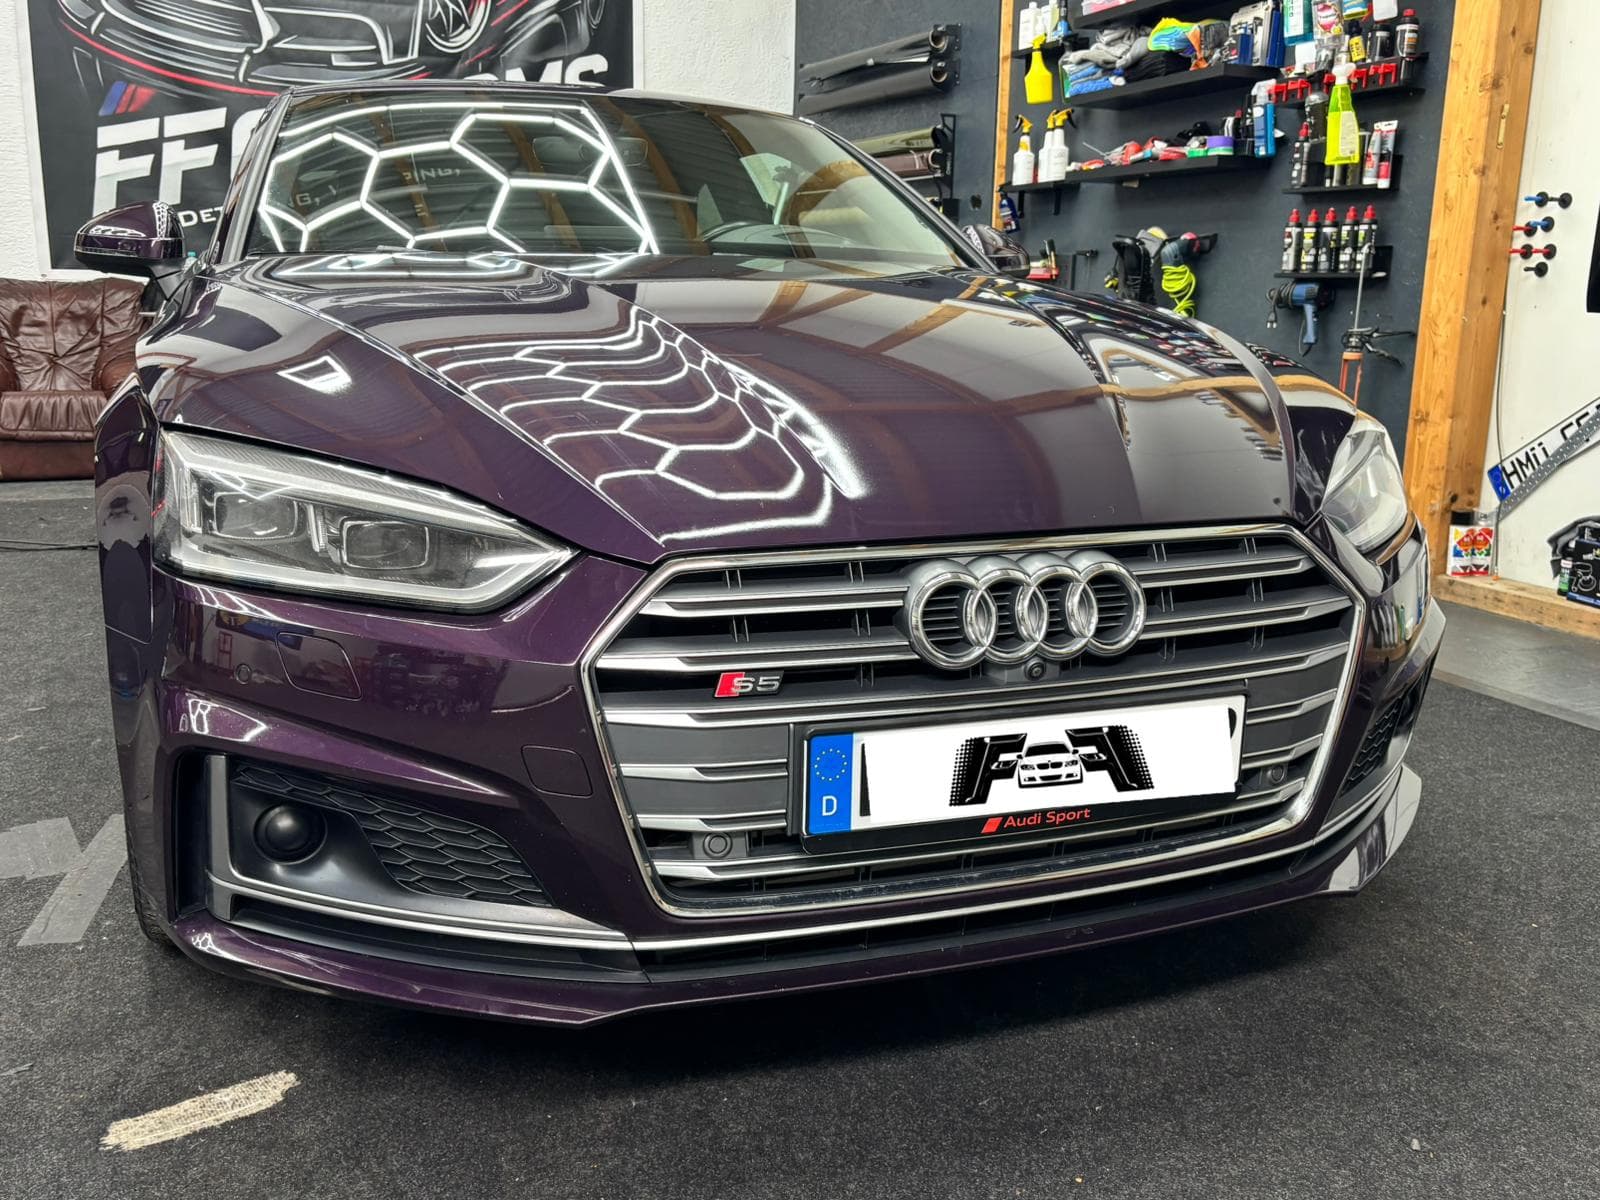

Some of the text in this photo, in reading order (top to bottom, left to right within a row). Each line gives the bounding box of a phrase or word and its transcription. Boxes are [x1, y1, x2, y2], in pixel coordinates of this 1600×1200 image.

[731, 676, 780, 693] S5
[822, 795, 837, 816] D
[1003, 808, 1091, 828] Audi Sport
